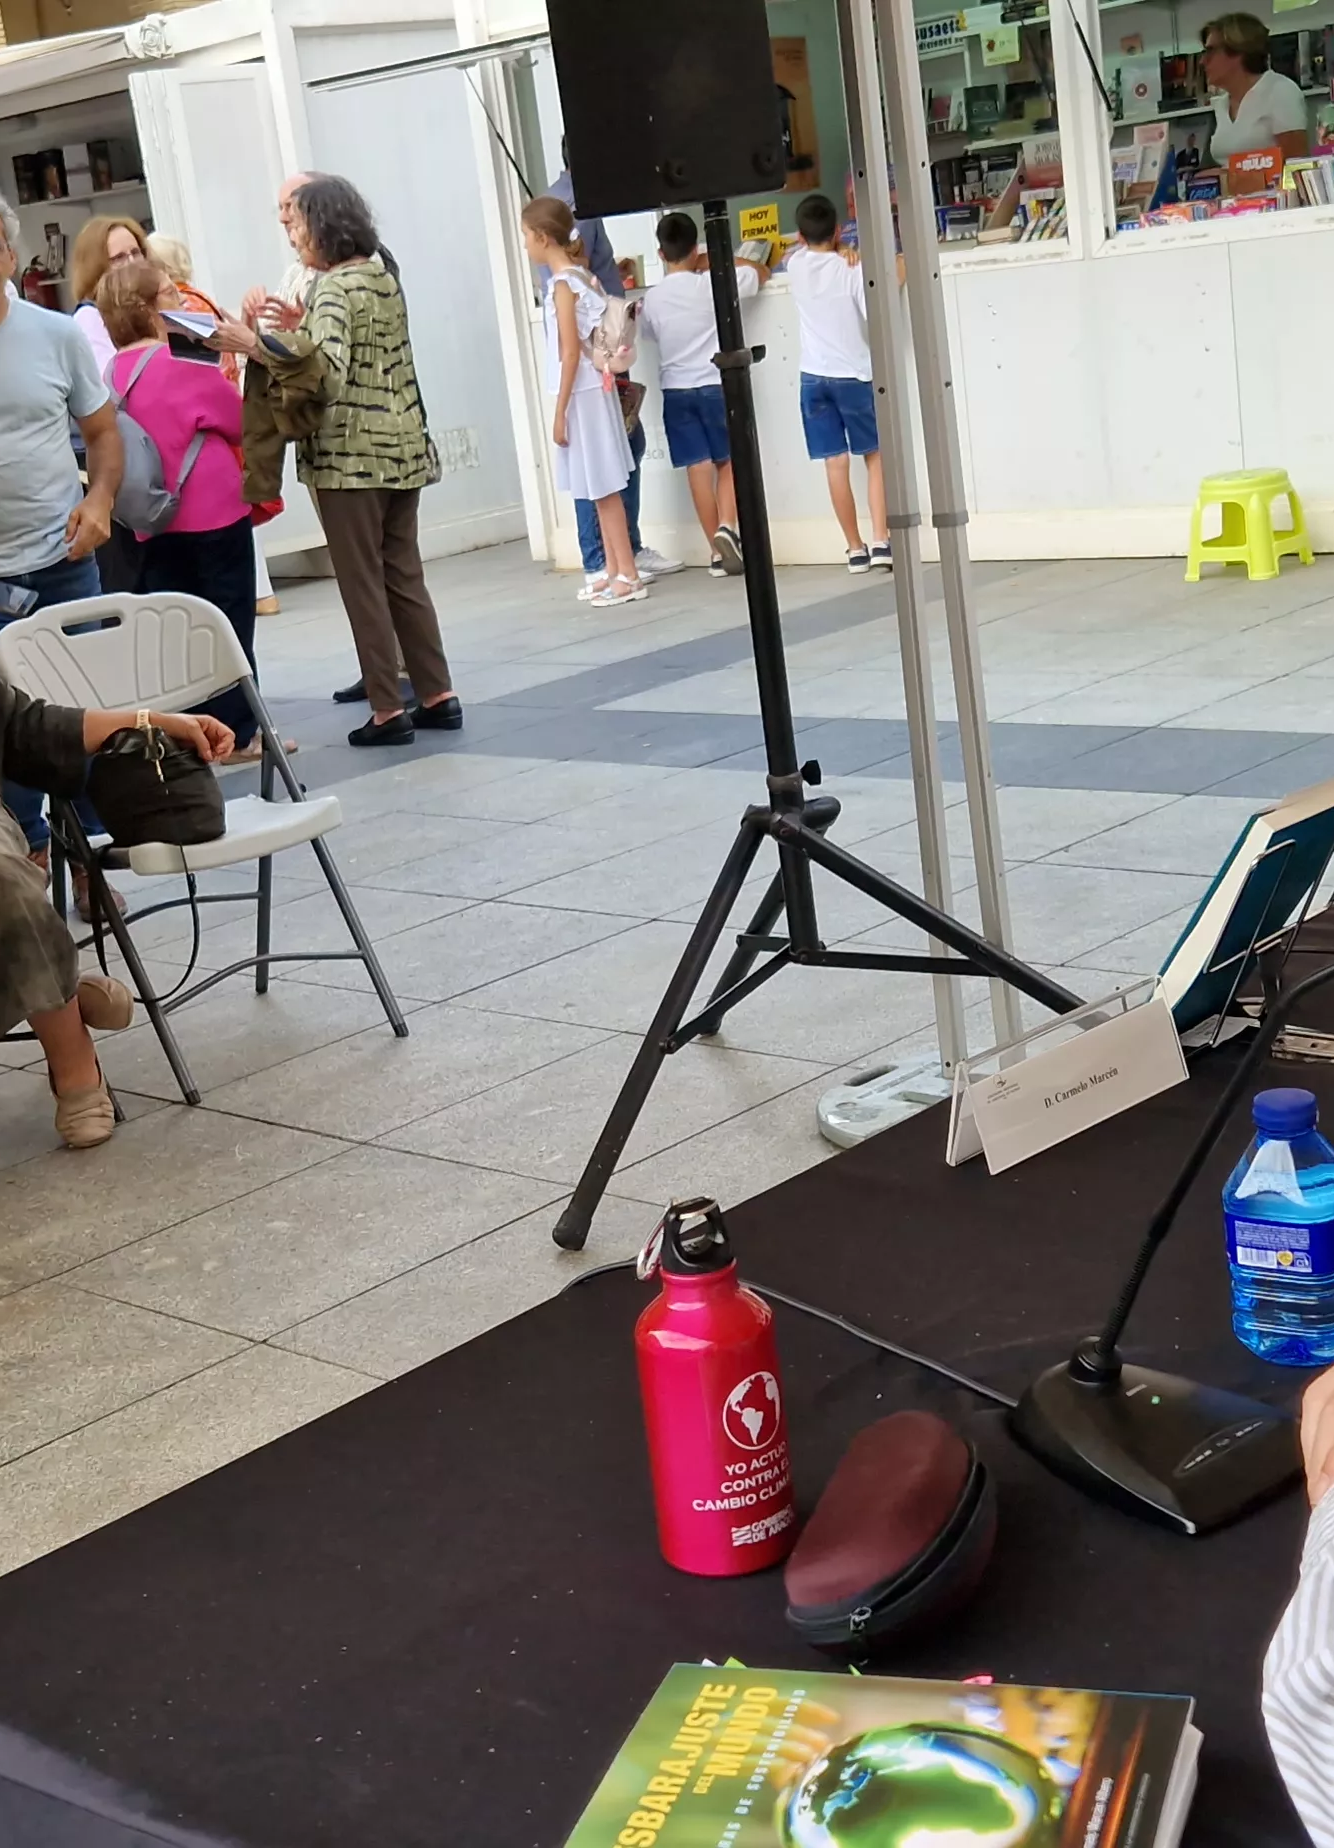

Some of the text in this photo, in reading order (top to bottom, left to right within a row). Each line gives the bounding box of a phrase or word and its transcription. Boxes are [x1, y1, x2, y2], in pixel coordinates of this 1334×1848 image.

[749, 209, 769, 221] HOY
[742, 223, 778, 239] FIRMAN
[1044, 1066, 1119, 1109] D. Carmelo Marcén
[720, 1466, 780, 1494] CONTRA
[724, 1462, 748, 1476] YO
[692, 1493, 757, 1512] CAMBIO
[752, 1528, 767, 1543] DE
[702, 1686, 779, 1777] MUNDO
[734, 1797, 754, 1816] DE
[746, 1688, 807, 1792] SOSTENIBILIDAD
[613, 1683, 737, 1848] SBARAJUSTE
